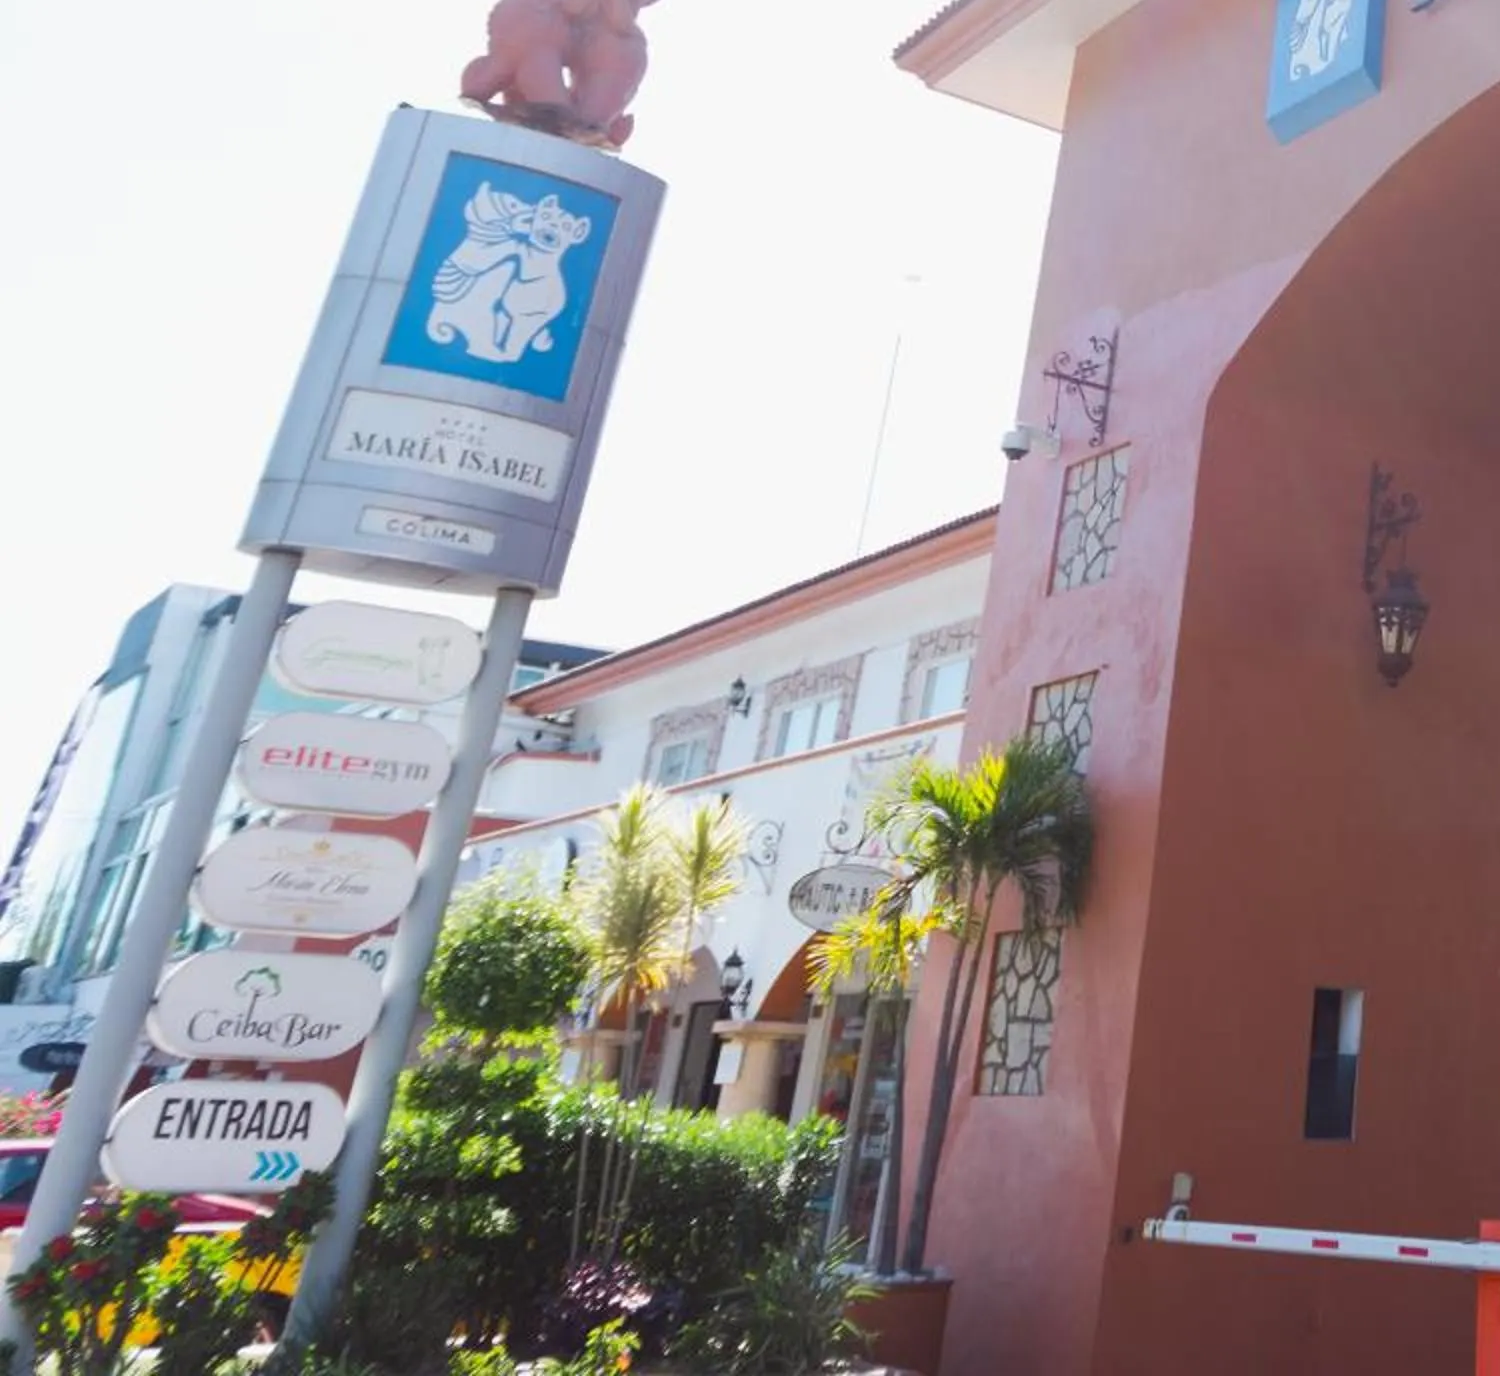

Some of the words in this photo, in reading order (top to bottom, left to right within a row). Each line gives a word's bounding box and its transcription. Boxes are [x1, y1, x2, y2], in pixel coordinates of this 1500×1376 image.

[434, 428, 486, 447] HOTEL
[345, 431, 447, 465] MARÍA
[457, 448, 548, 488] ISABEL
[386, 518, 471, 544] COLIMA
[187, 1008, 276, 1043] Ceiba
[279, 1012, 342, 1048] Bar
[153, 1098, 313, 1141] ENTRADA
